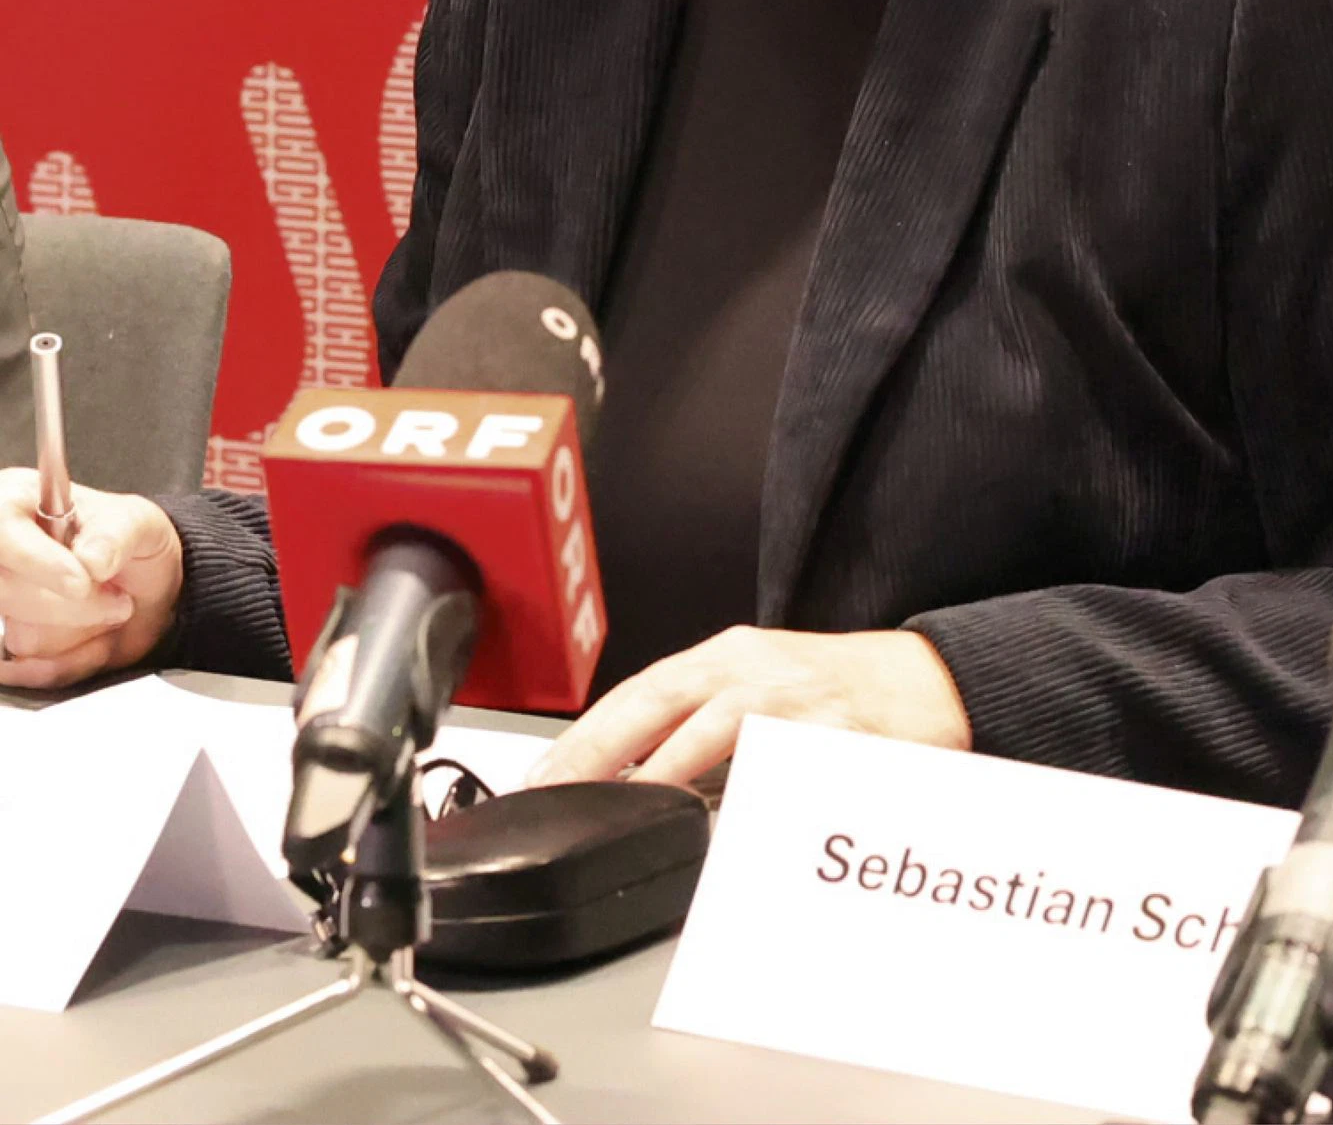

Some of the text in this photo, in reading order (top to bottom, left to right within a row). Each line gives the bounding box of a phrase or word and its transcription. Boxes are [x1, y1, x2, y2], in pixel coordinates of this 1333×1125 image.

[296, 405, 543, 458] ORF
[553, 445, 599, 653] ORF
[816, 833, 1114, 933] Sebastian
